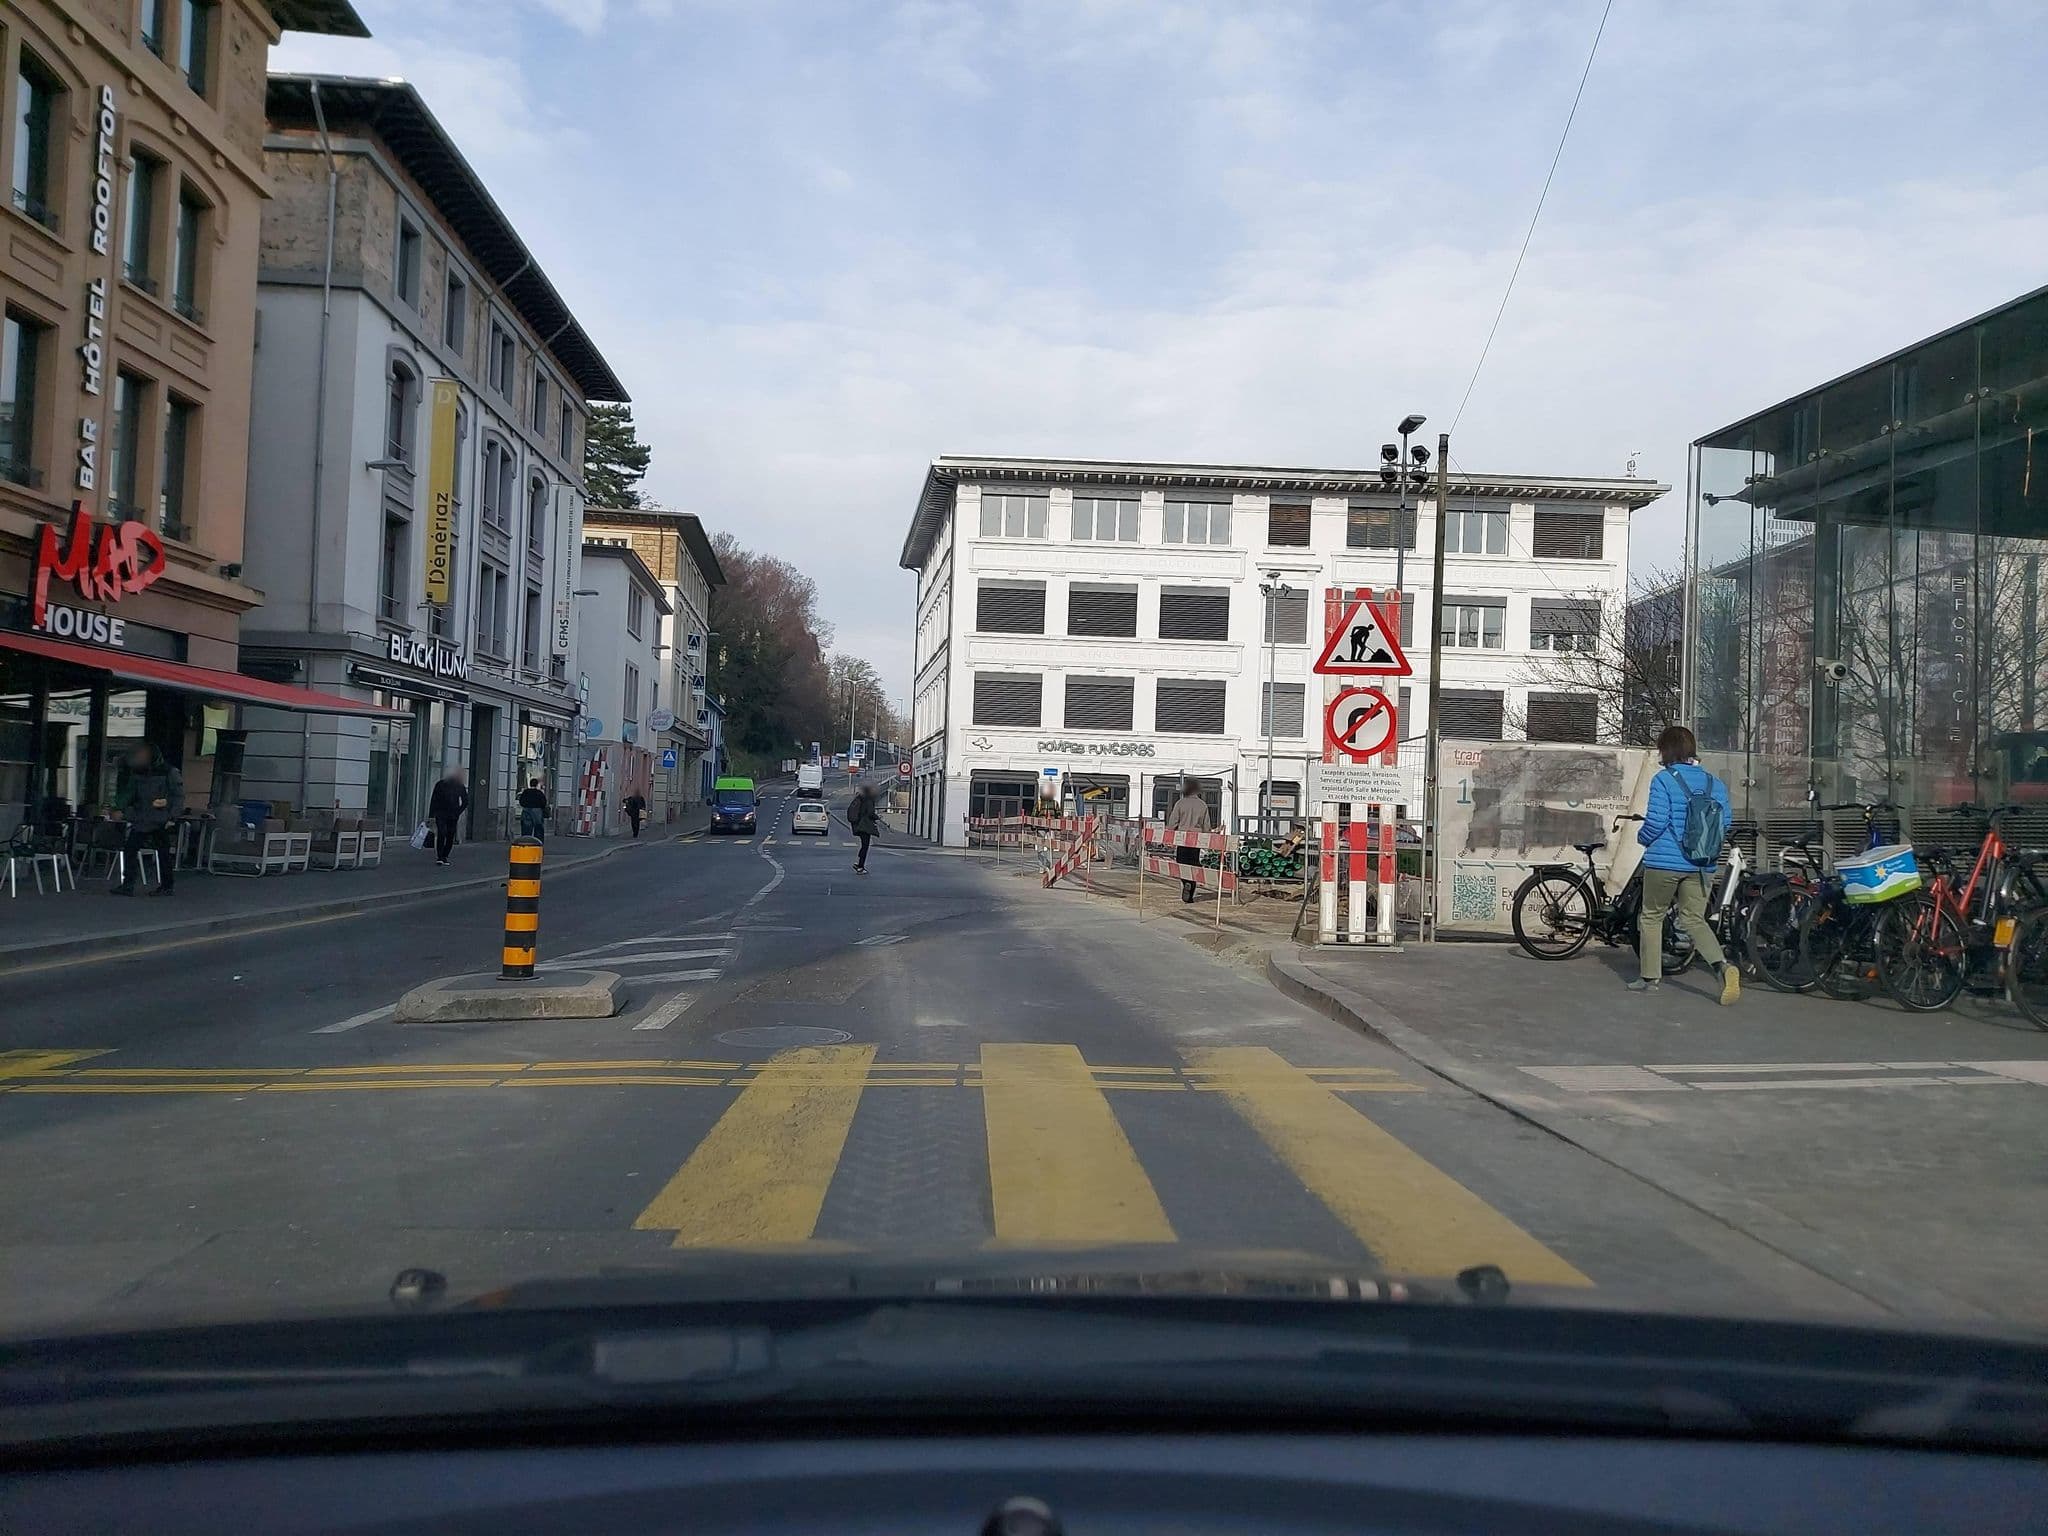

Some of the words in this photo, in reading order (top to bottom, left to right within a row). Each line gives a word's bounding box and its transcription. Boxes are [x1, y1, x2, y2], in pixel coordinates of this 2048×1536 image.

[92, 84, 116, 257] ROOFTOP
[82, 278, 106, 396] HÔTEL
[79, 417, 97, 490] BAR
[32, 604, 126, 647] HOUSE
[558, 619, 569, 648] CFMS
[391, 633, 434, 671] BLACK
[440, 648, 469, 681] LUNA
